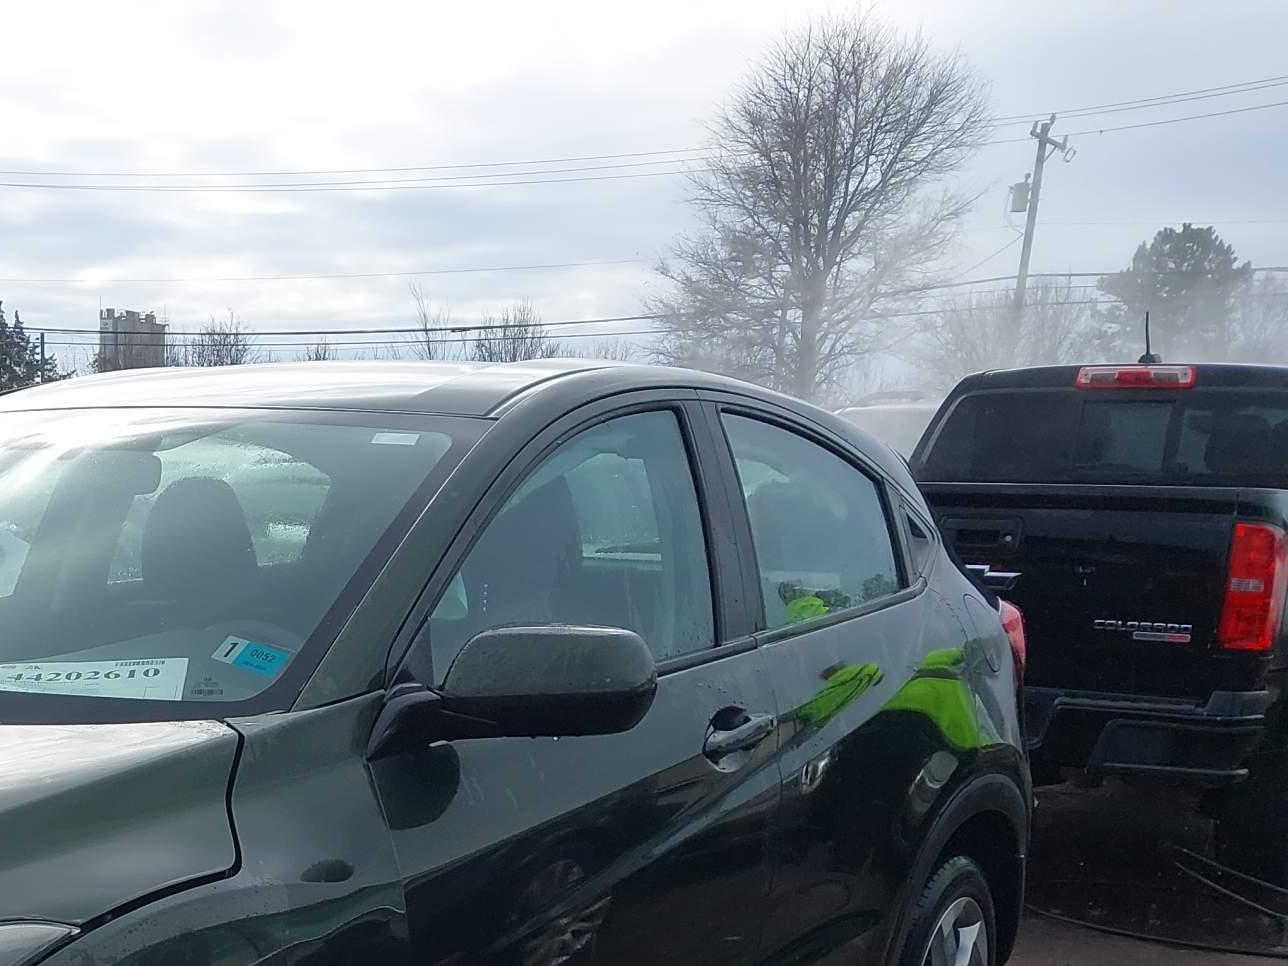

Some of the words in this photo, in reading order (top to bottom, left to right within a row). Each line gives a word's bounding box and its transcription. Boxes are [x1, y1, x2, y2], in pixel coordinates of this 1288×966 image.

[1093, 619, 1193, 634] COLORADO
[220, 642, 239, 659] 1
[7, 666, 161, 683] 44202610
